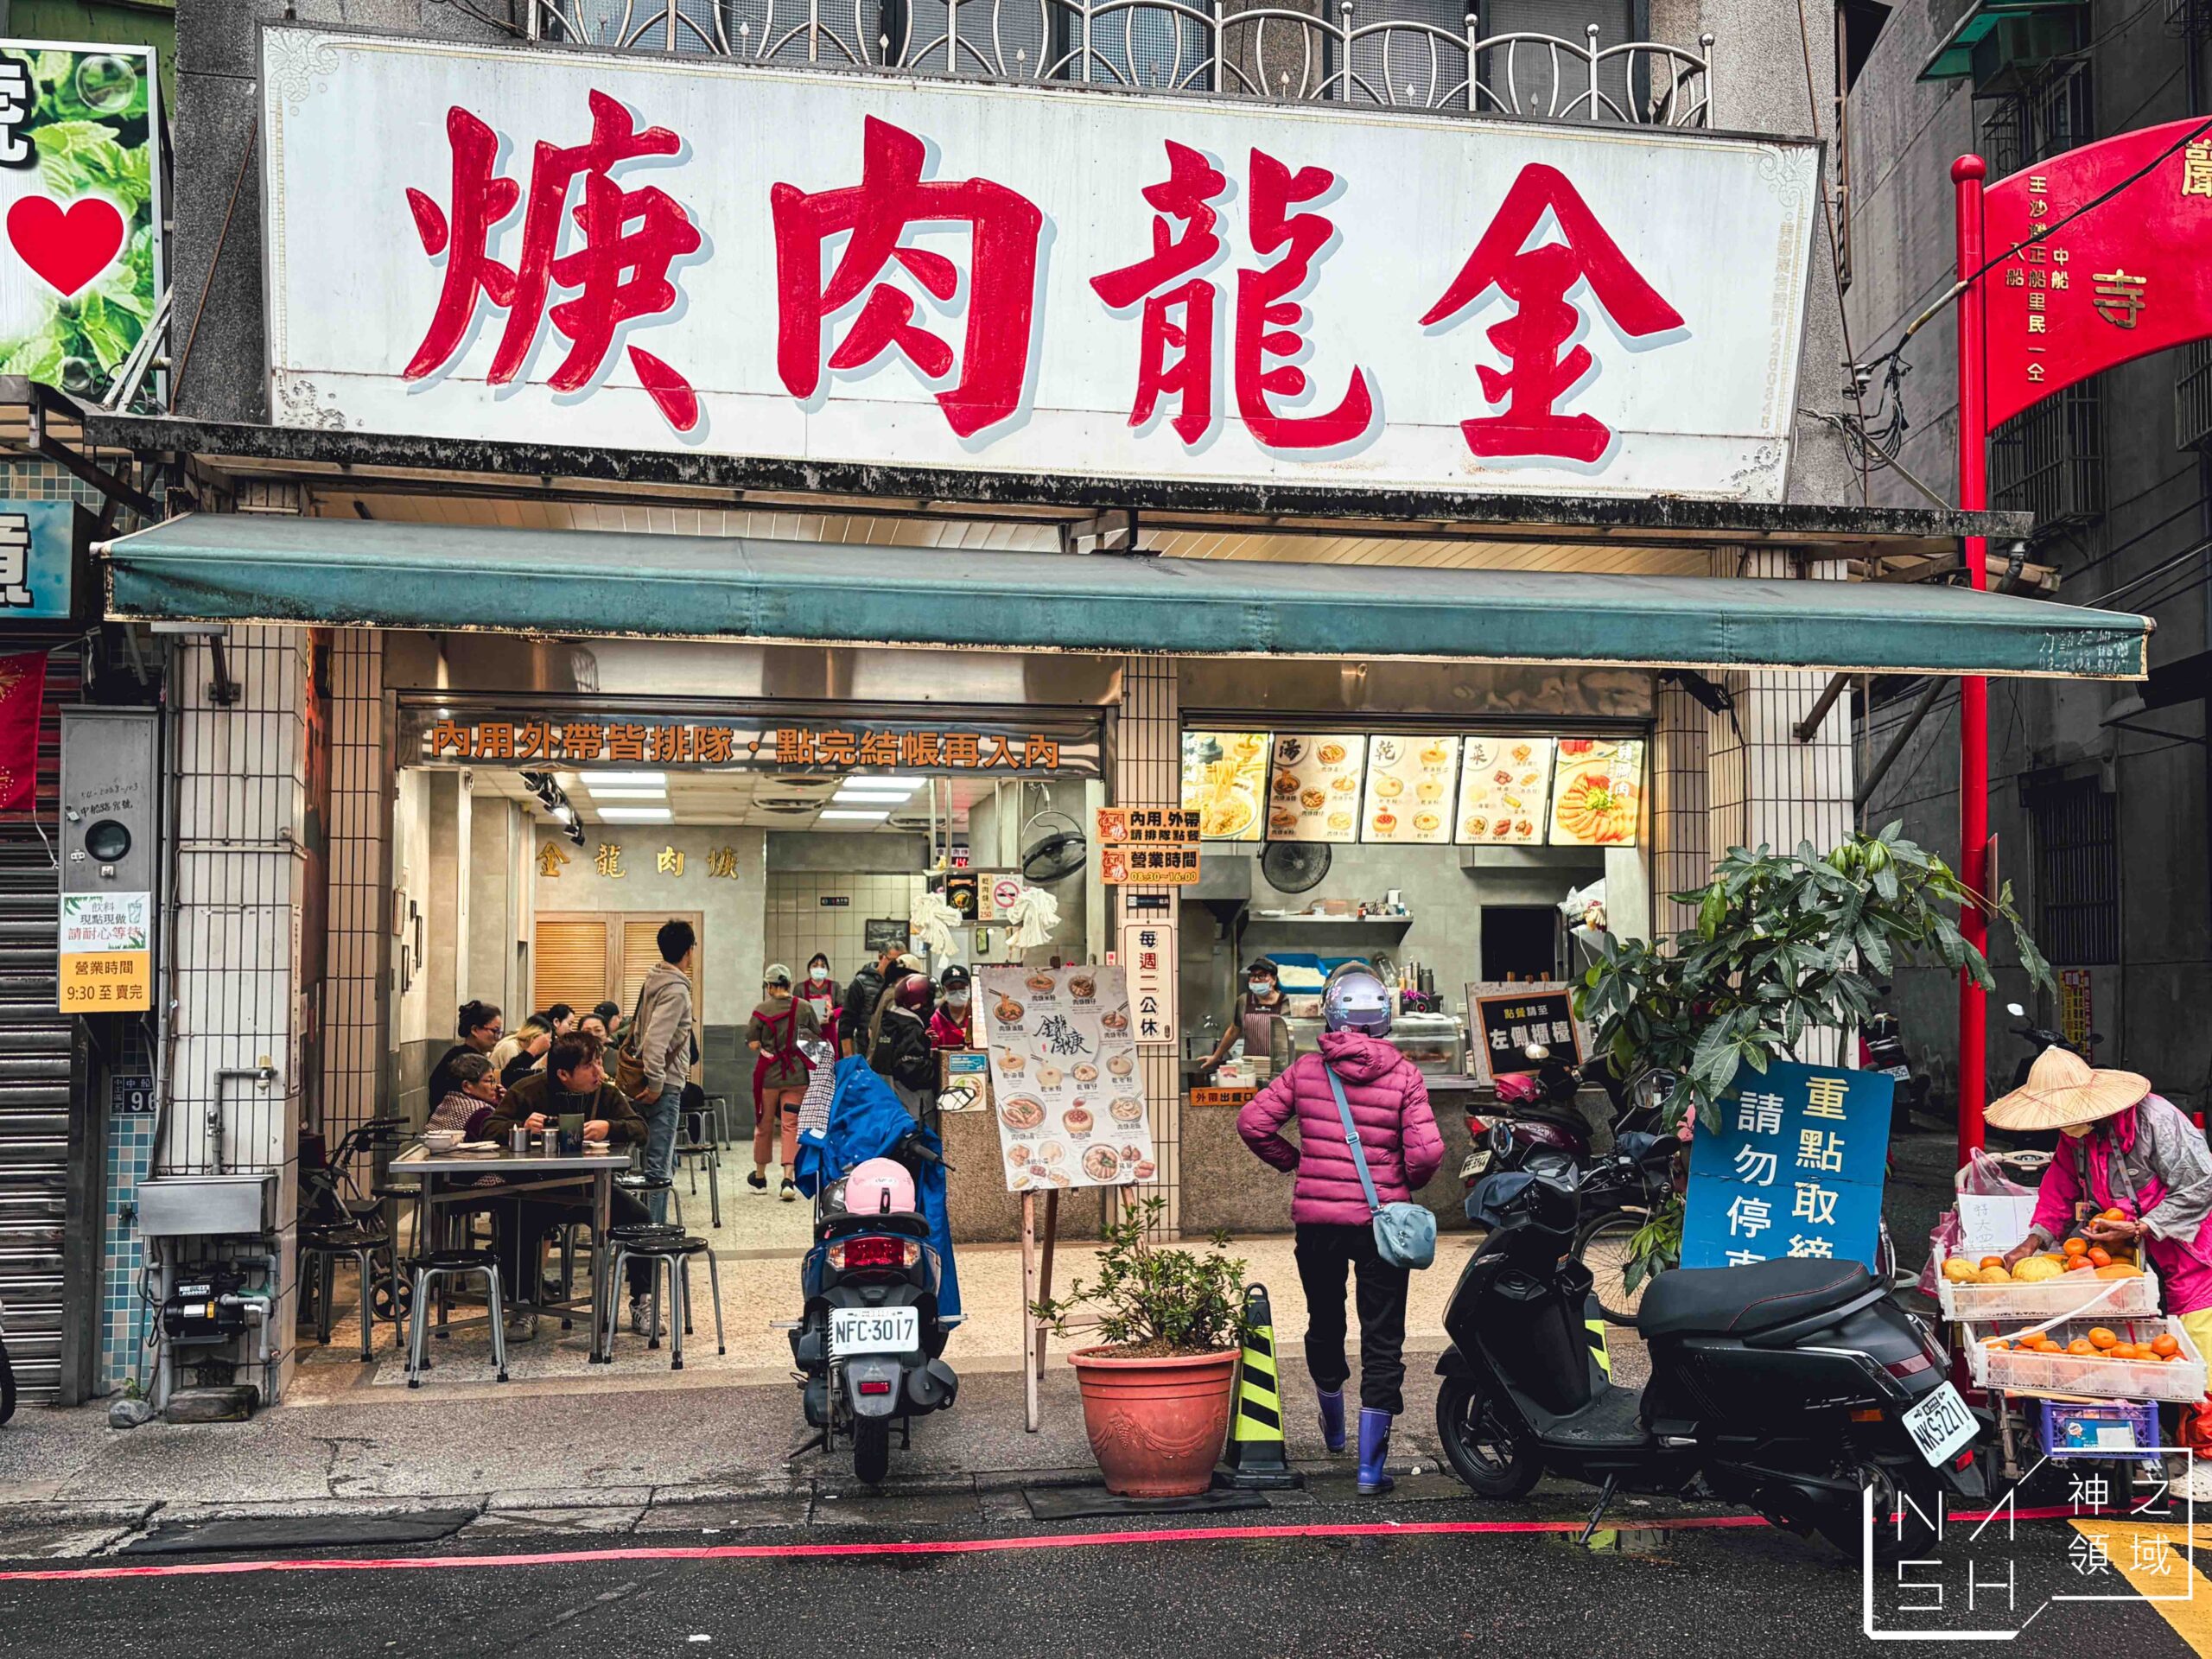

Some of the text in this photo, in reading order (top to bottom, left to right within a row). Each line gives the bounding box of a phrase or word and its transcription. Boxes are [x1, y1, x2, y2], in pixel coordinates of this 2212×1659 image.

[1130, 830, 1199, 842] 請排隊點餐
[1131, 851, 1197, 868] 營業時間
[92, 901, 114, 912] 飲料
[80, 913, 126, 925] 現點現做
[68, 925, 142, 941] 請耐心等待
[75, 961, 133, 976] 營業時間
[1139, 931, 1159, 1036] 每週二公休
[67, 984, 143, 1001] 9:30 至 賣完
[1503, 1004, 1548, 1020] 點餐請至
